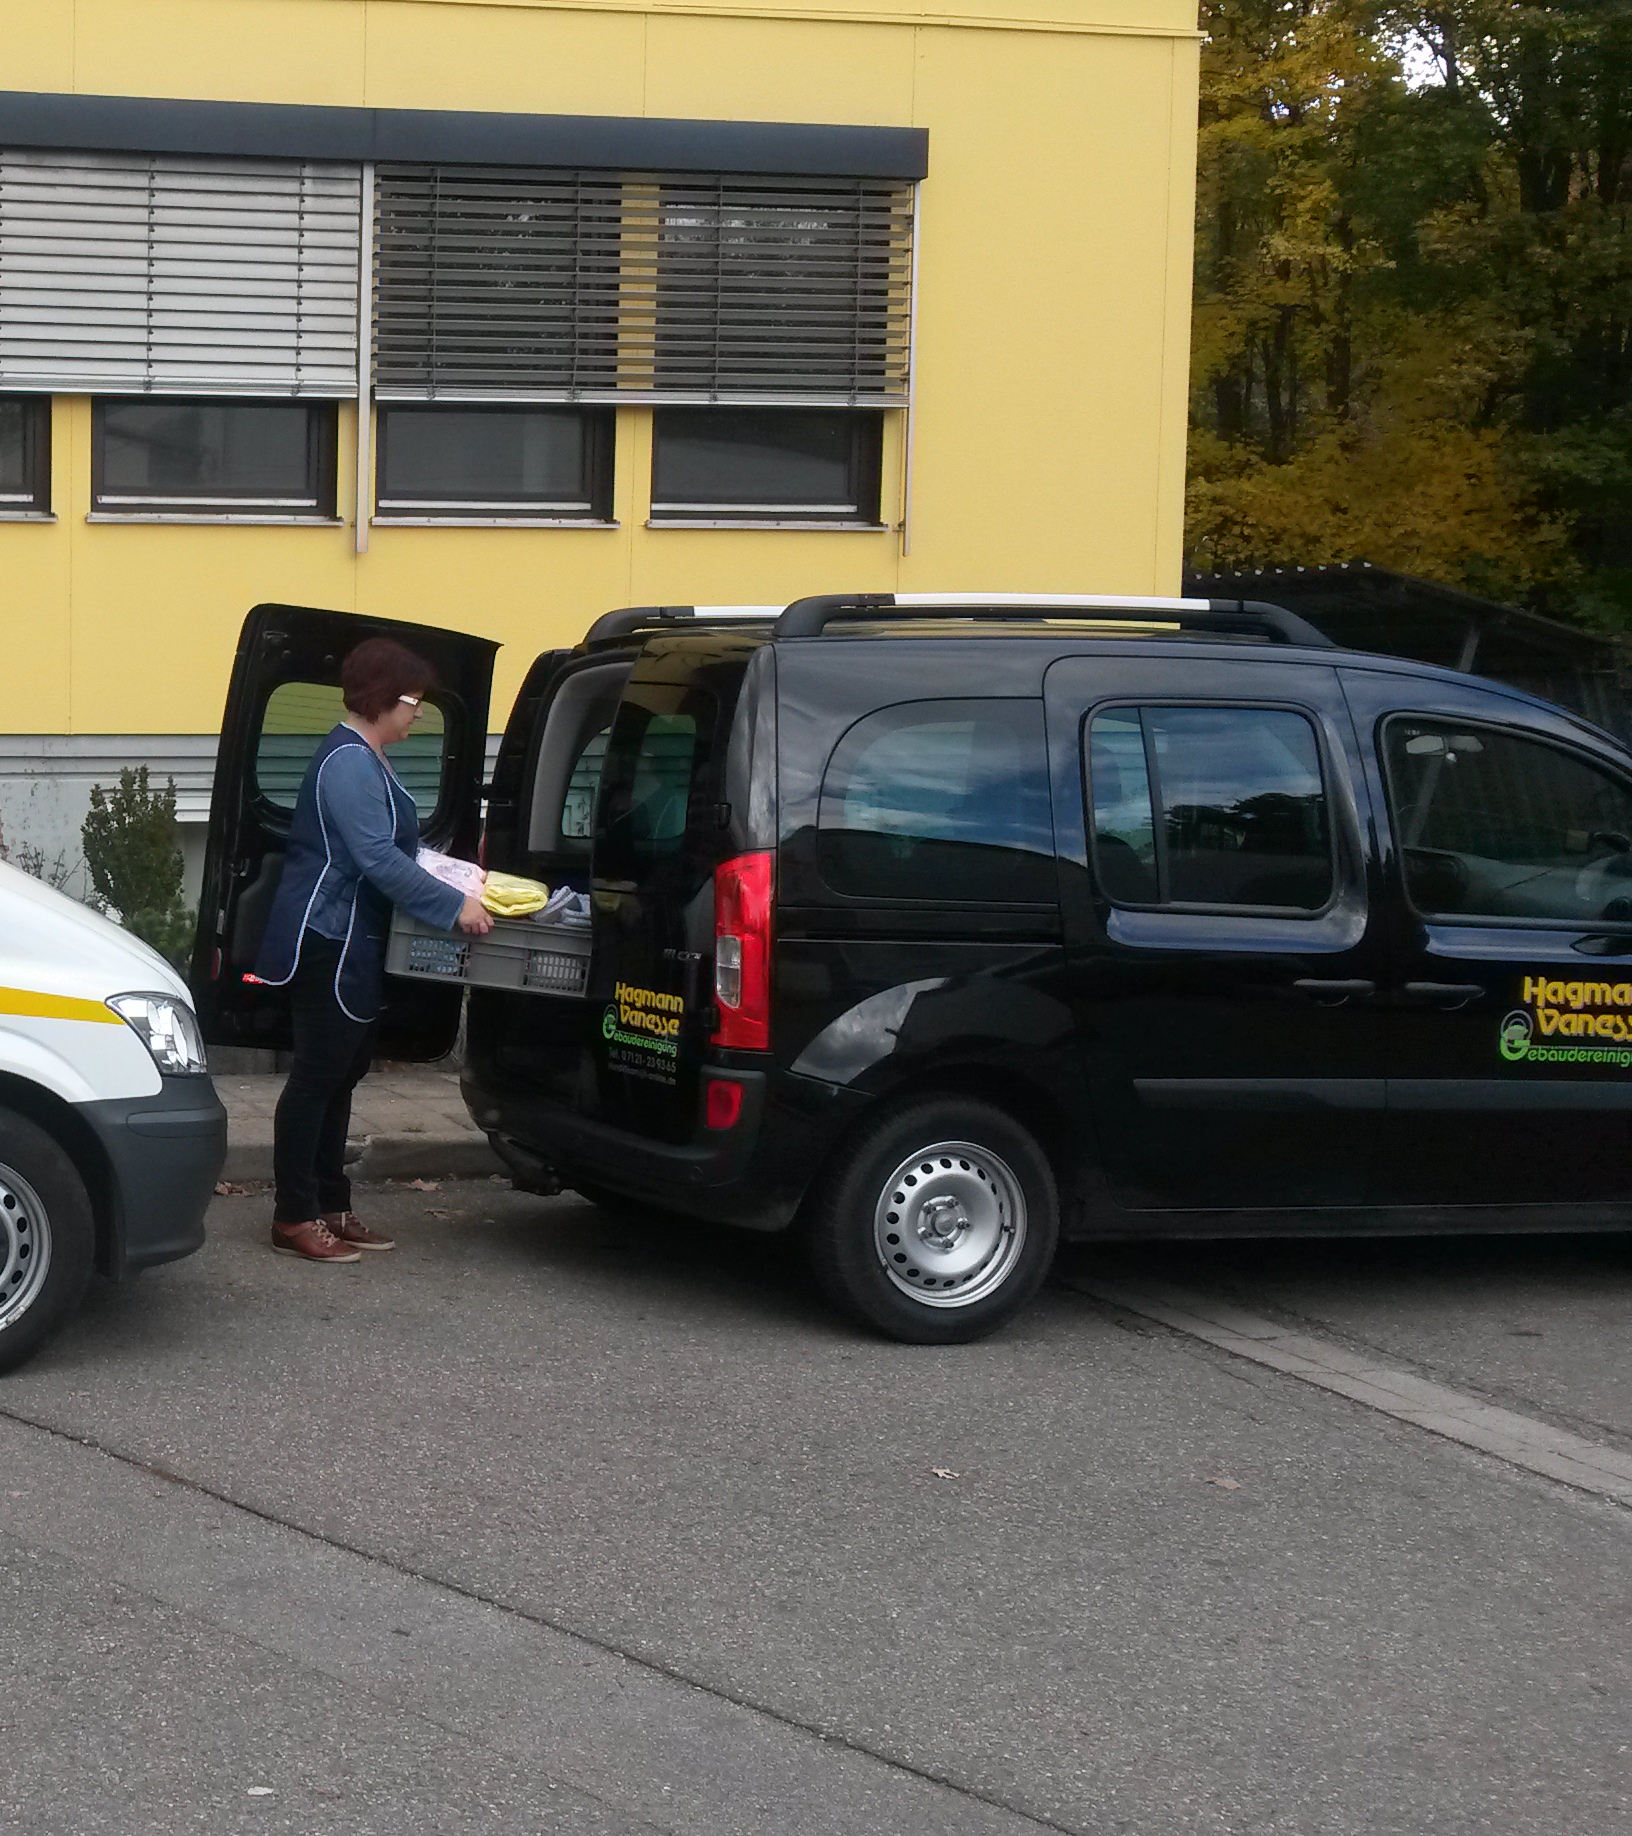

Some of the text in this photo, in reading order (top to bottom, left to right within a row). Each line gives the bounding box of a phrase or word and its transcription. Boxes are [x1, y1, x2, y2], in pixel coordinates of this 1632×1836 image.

[614, 981, 684, 1014] Hagmann
[619, 1004, 680, 1036] Vanesse
[1500, 1024, 1632, 1068] Gebäudereinig
